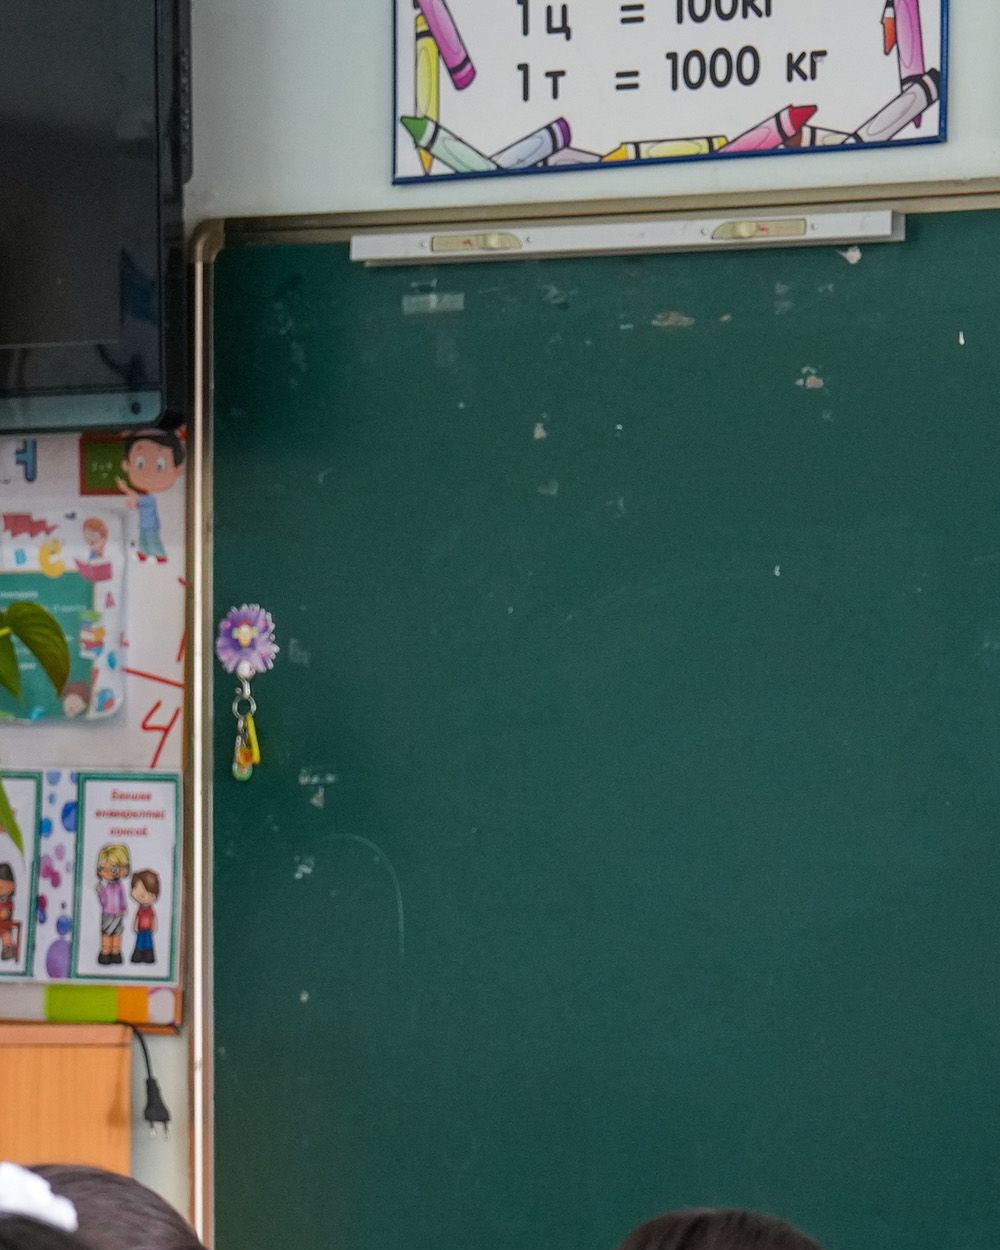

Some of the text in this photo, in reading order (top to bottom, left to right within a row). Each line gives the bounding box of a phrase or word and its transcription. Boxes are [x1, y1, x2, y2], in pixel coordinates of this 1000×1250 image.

[516, 0, 530, 36] 1
[545, 3, 572, 42] ц
[516, 62, 530, 103] 1
[544, 69, 567, 100] т
[665, 45, 761, 92] 1000
[786, 49, 828, 83] кг
